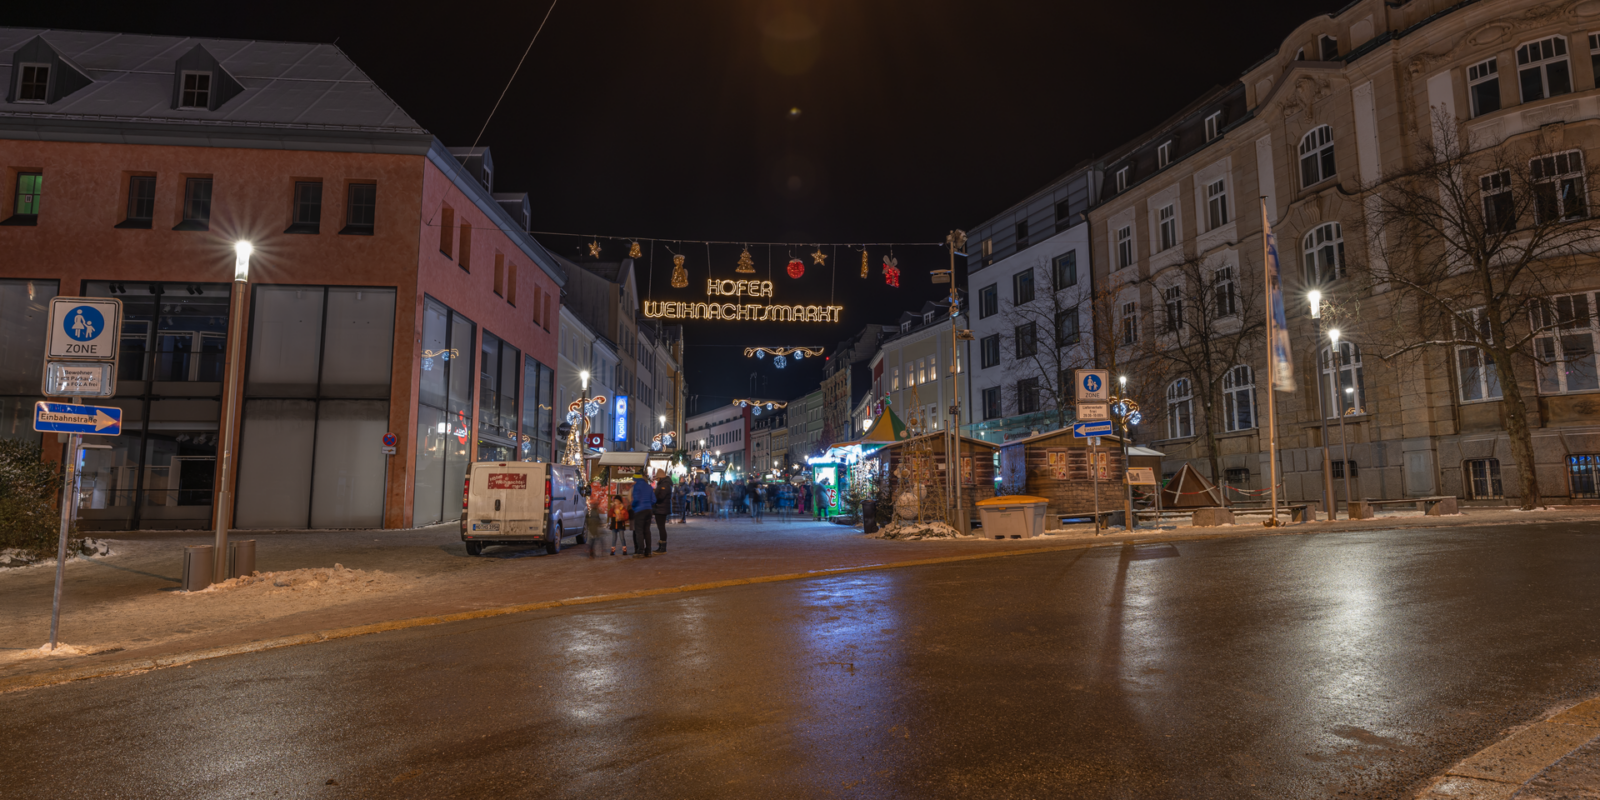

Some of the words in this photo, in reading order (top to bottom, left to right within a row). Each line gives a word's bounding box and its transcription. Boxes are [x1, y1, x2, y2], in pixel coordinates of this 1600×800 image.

[707, 279, 774, 297] HOFER
[644, 301, 843, 323] WEIHNACHTSMARKT
[65, 344, 98, 354] ZONE
[41, 413, 98, 424] Einbahnstraße
[617, 417, 625, 439] Apollo
